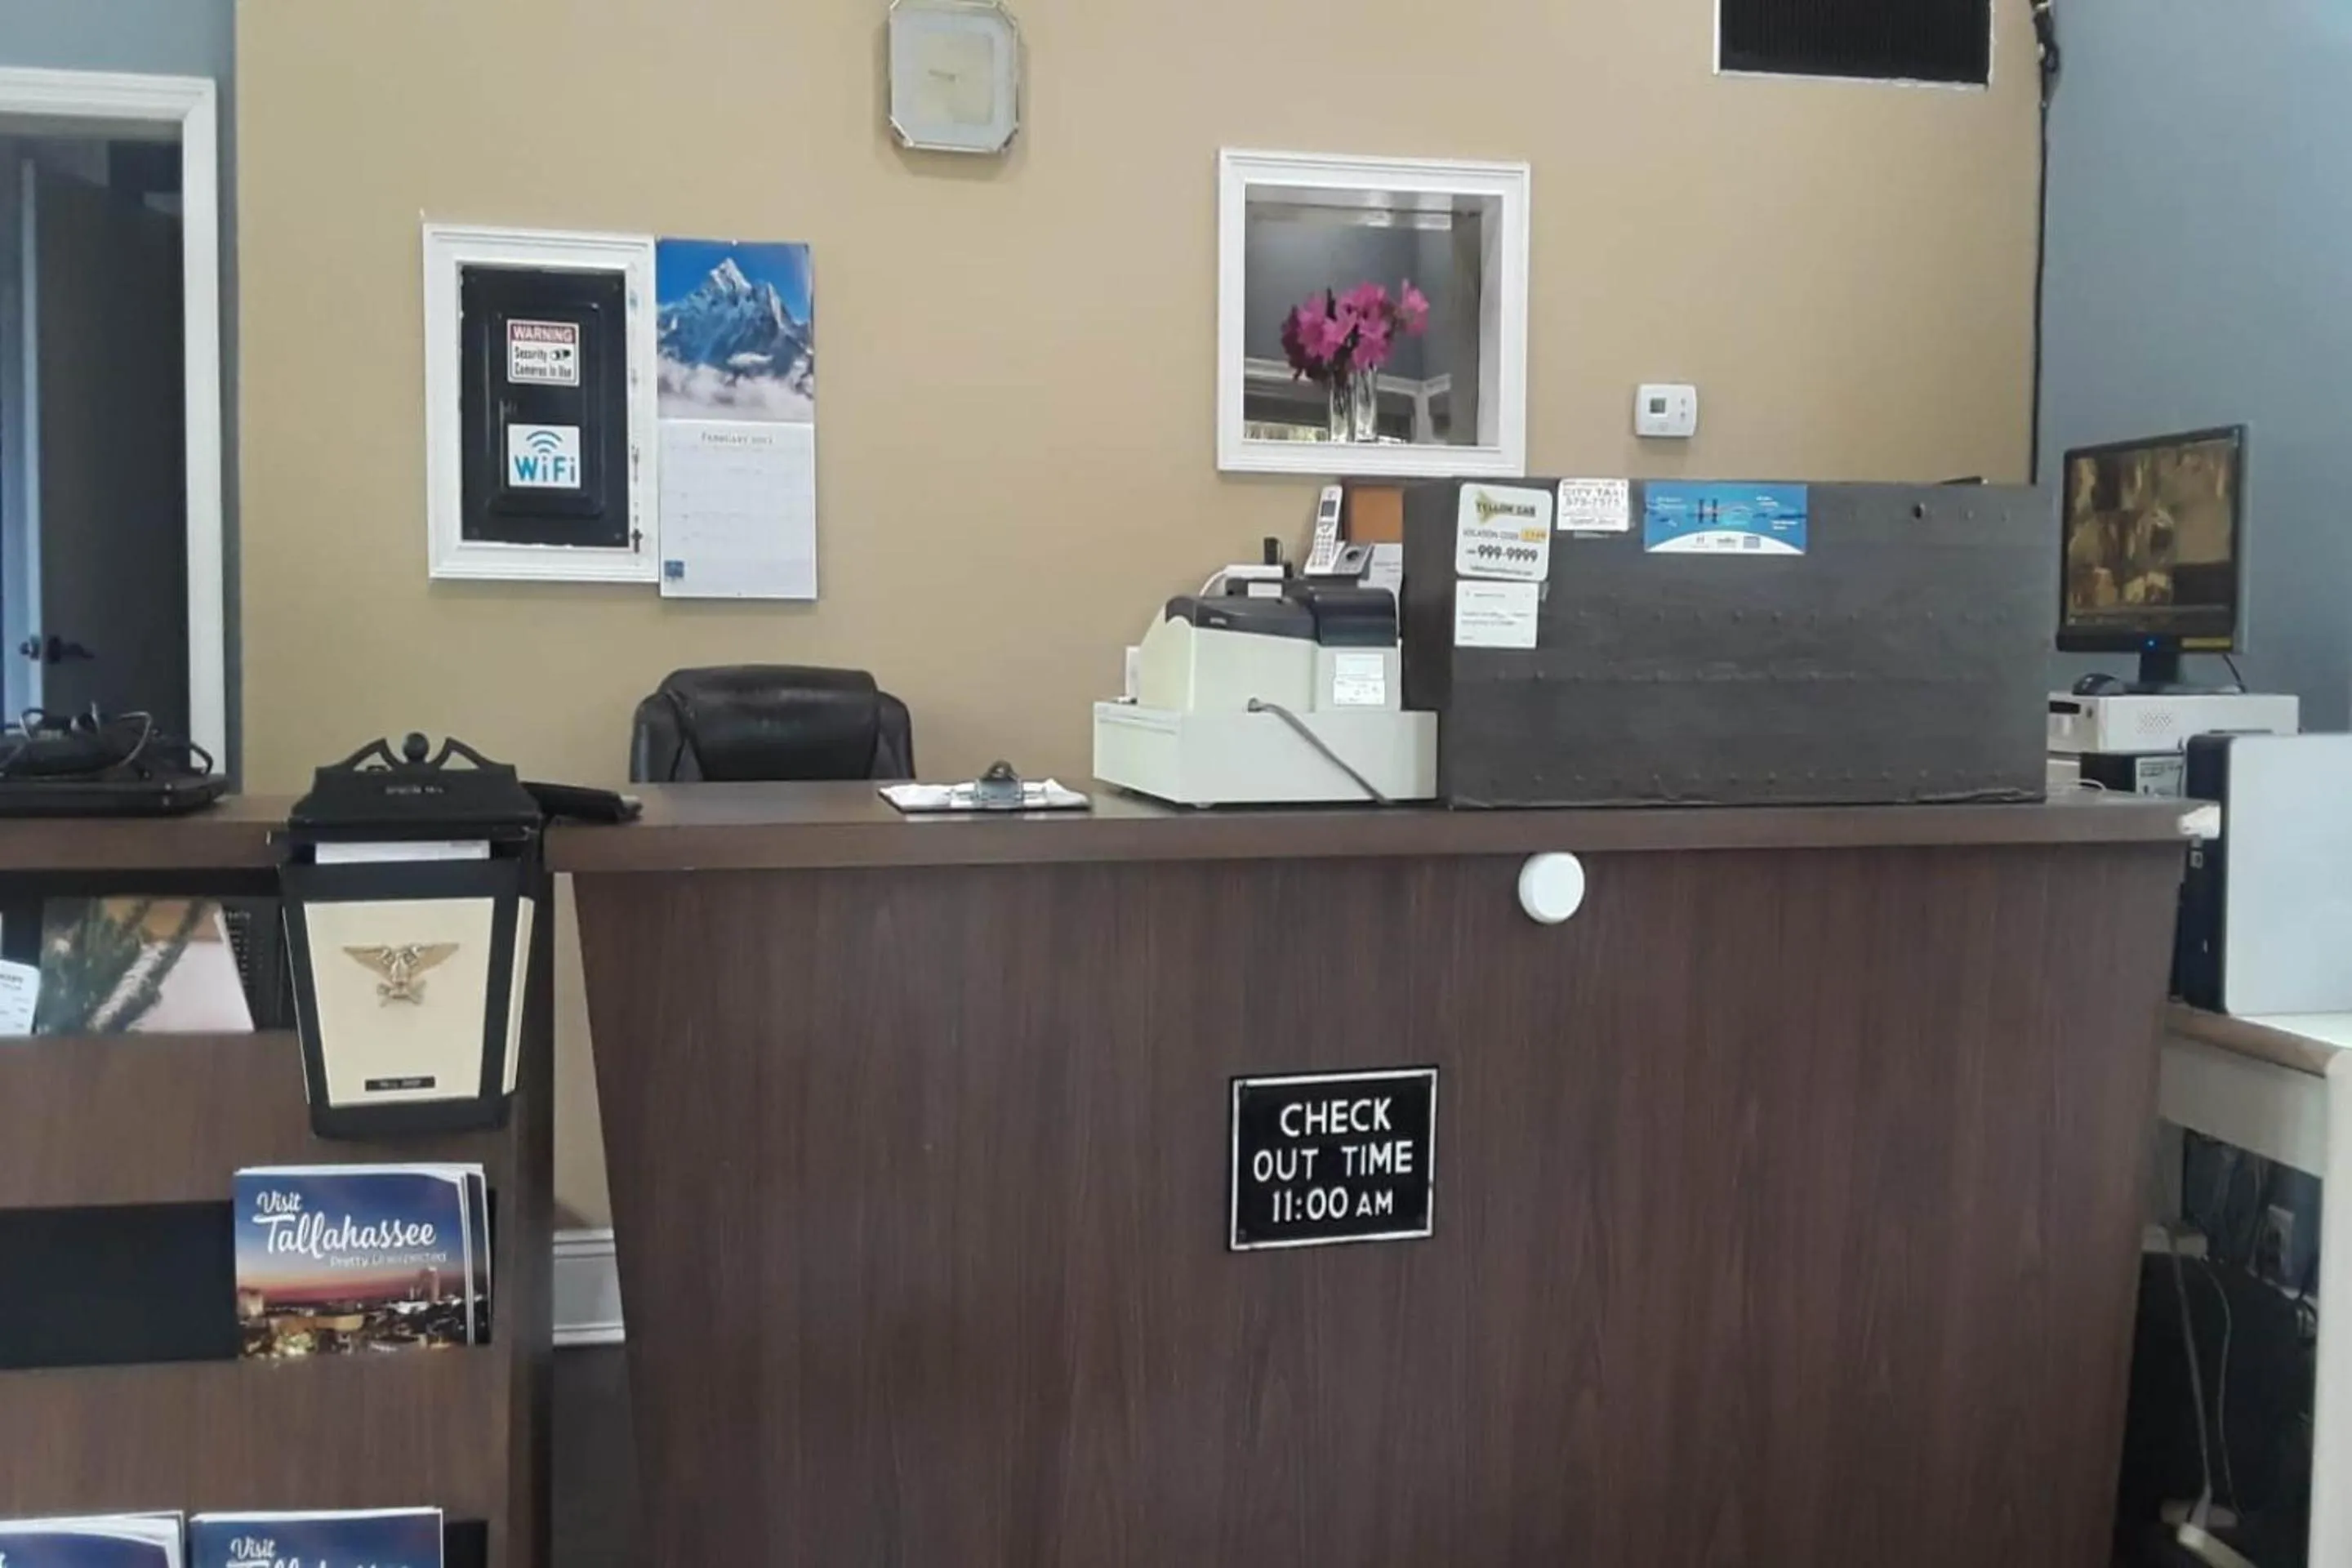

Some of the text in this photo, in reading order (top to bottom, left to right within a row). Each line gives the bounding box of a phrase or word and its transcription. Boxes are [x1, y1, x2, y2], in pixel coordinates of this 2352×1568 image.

[512, 326, 573, 343] WARNING
[514, 345, 547, 363] Security
[514, 362, 547, 376] Cameras
[514, 454, 575, 483] WiFi
[1476, 501, 1514, 516] YELLOW
[1477, 543, 1539, 563] 999-9999
[1280, 1098, 1392, 1138] CHECK
[1253, 1140, 1414, 1182] OUT TIME
[256, 1190, 302, 1214] Visit
[1272, 1187, 1394, 1223] 11:00 AM
[252, 1211, 436, 1258] Tallahassee
[230, 1536, 276, 1560] Visit
